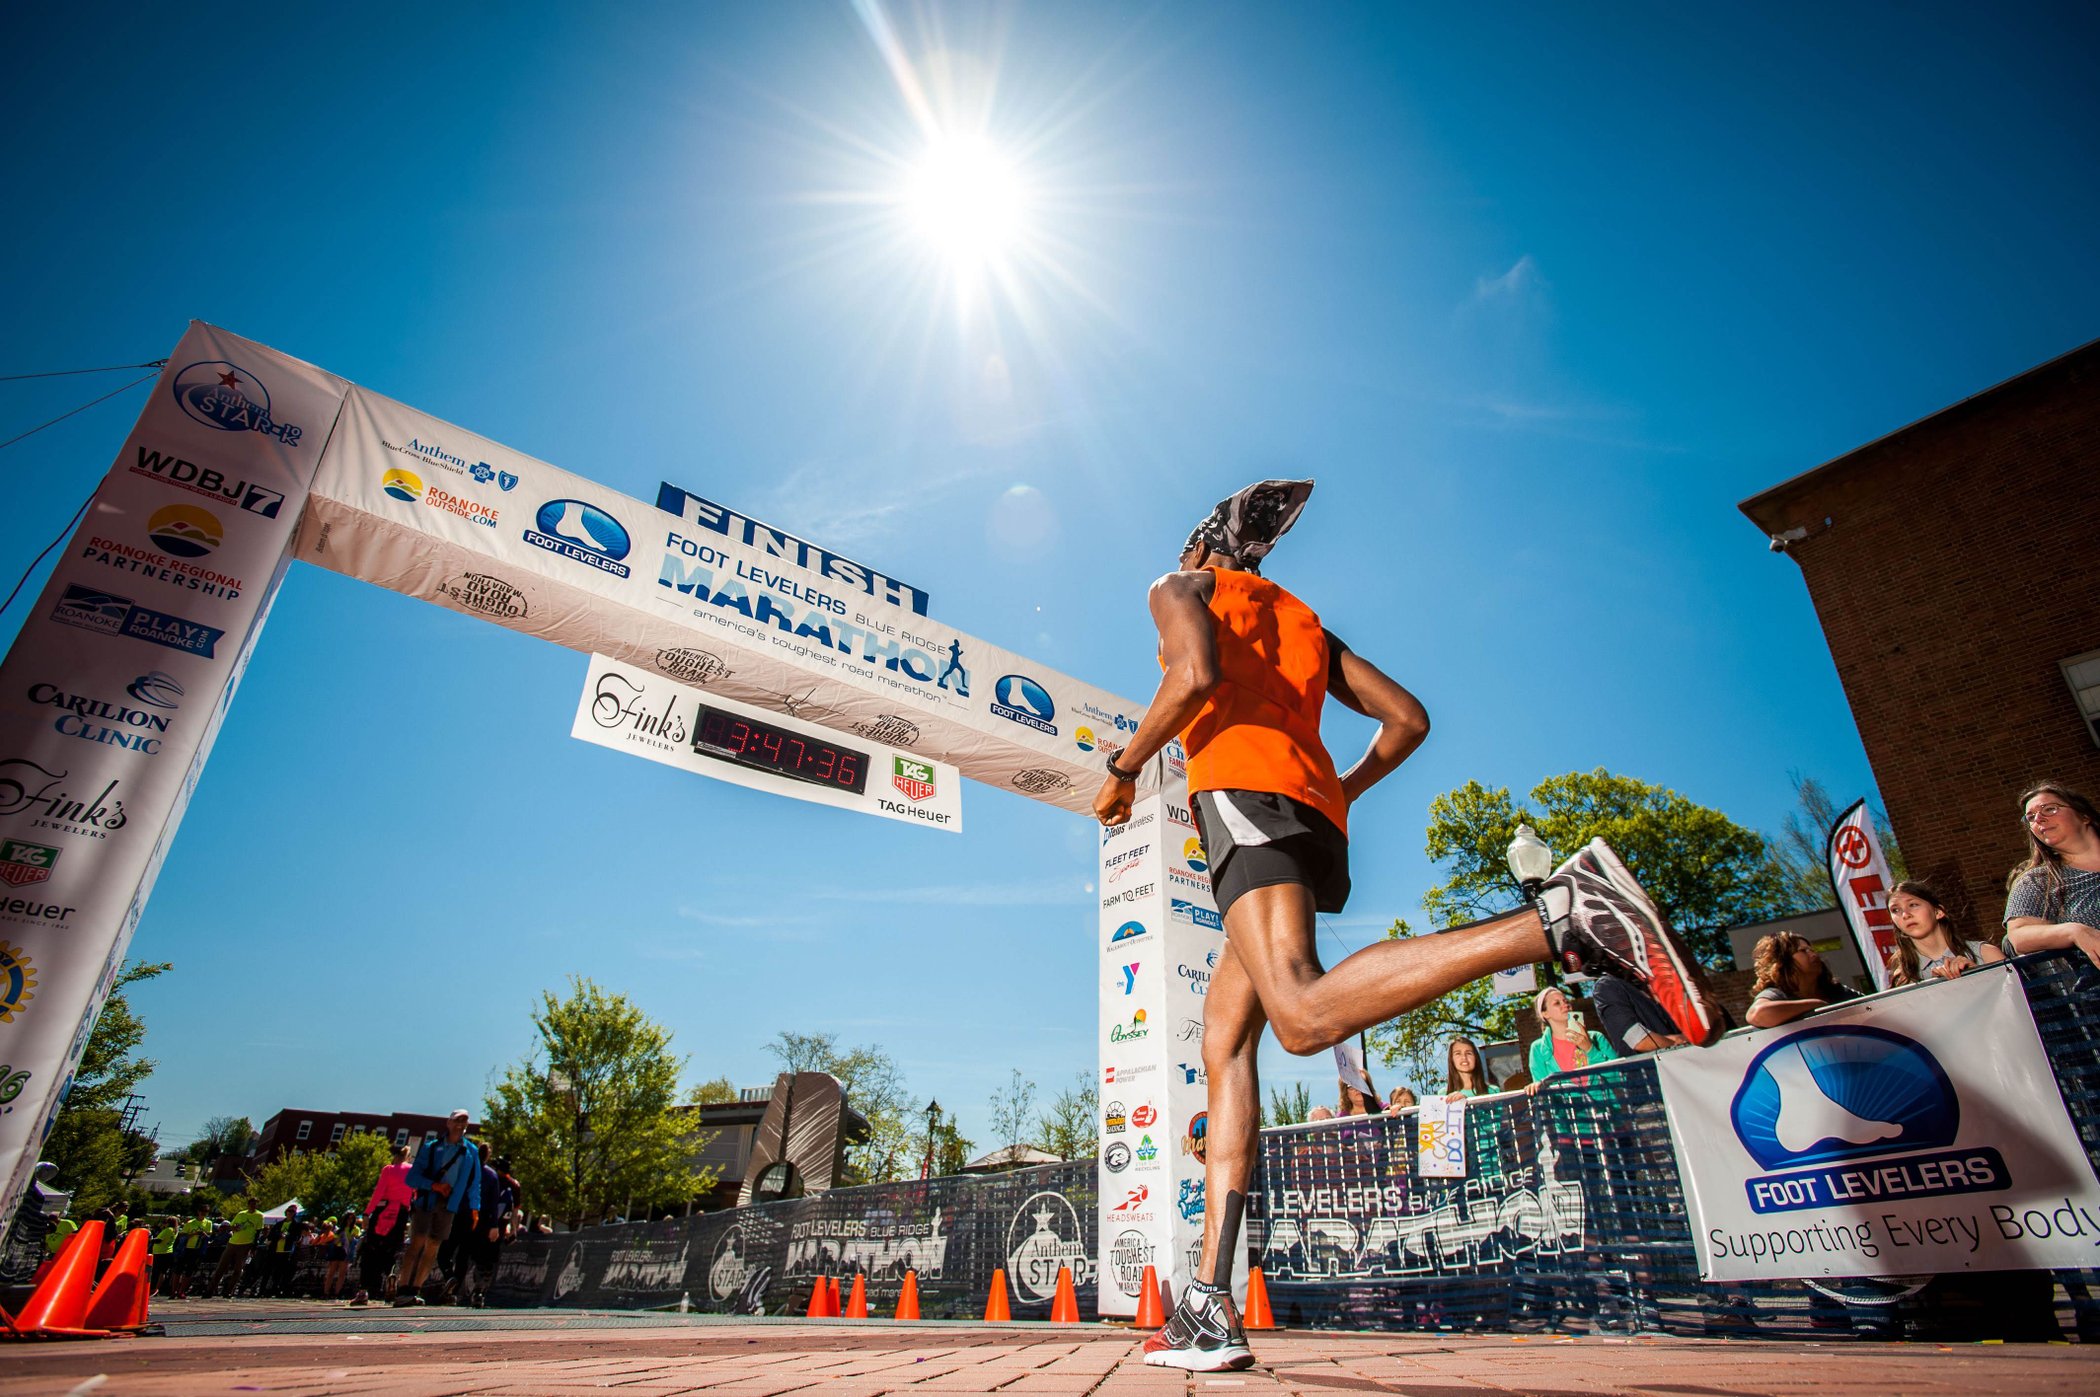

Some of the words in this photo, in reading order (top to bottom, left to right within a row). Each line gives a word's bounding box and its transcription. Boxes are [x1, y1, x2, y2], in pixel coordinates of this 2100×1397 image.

[207, 387, 269, 418] Anthem
[382, 440, 421, 460] BlueCross
[422, 456, 464, 476] BlueShield
[408, 438, 466, 467] Anthem
[425, 496, 497, 529] OUTSIDE.COM
[428, 486, 499, 521] ROANOKE
[89, 536, 167, 567] ROANOKE
[168, 560, 243, 590] REGIONAL
[527, 532, 563, 554] FOOT
[564, 547, 627, 577] LEVELERS
[682, 494, 914, 614] FINISH
[82, 547, 240, 600] PARTNERSHIP
[464, 572, 522, 598] MARATHON
[436, 583, 528, 619] TOUGHEST
[467, 581, 512, 604] ROAD
[666, 532, 730, 569] FOOT
[736, 560, 847, 615] LEVELERS
[855, 613, 896, 637] BLUE
[900, 631, 946, 655] RIDGE
[56, 606, 121, 629] ROANOKE
[134, 612, 200, 638] PLAY
[657, 553, 971, 698] MARATHON
[129, 625, 195, 648] ROANOKE
[657, 648, 736, 679] TOUGHEST
[692, 607, 767, 642] america's
[771, 636, 838, 668] toughest
[841, 661, 874, 680] road
[876, 671, 942, 704] marathon
[668, 662, 707, 680] ROAD
[28, 683, 172, 732] CARILION
[592, 673, 686, 743] Fink's
[992, 705, 1015, 718] FOOT
[1016, 712, 1056, 734] LEVELERS
[1083, 703, 1112, 720] Anthem
[54, 715, 162, 755] CLINIC
[875, 720, 909, 737] ROAD
[877, 714, 919, 732] MARATHON
[627, 733, 675, 752] JEWELERS
[900, 760, 929, 780] TAG
[0, 758, 128, 830] Fink's
[896, 778, 932, 799] HEUER
[878, 799, 905, 814] TAG
[908, 806, 951, 824] Heuer
[1128, 813, 1154, 830] wireless
[31, 819, 108, 840] JEWELERS
[10, 844, 50, 865] TAG
[1105, 853, 1127, 869] FLEET
[1128, 844, 1150, 859] FEET
[1169, 867, 1196, 881] ROANOKE
[1169, 875, 1211, 893] PARTNERS
[1103, 894, 1121, 909] FARM
[1135, 883, 1155, 898] FEET
[1194, 909, 1216, 922] PLAY
[1446, 1105, 1462, 1134] IT
[1420, 1122, 1435, 1153] YOU
[1432, 1120, 1447, 1159] CAN
[1447, 1139, 1463, 1162] DO
[1269, 1187, 1402, 1214] LEVELERS
[1409, 1189, 1457, 1212] BLUE
[1464, 1167, 1535, 1196] RIDGE
[1753, 1178, 1820, 1208] FOOT
[1825, 1156, 1995, 1201] LEVELERS
[791, 1223, 811, 1239] FOOT
[811, 1219, 867, 1237] LEVELERS
[871, 1225, 896, 1238] BLUE
[898, 1223, 930, 1235] RIDGE
[1107, 1213, 1154, 1222] HEADSWEATS
[1247, 1180, 1585, 1277] ARATHON
[1710, 1220, 1880, 1264] Supporting
[1881, 1209, 1981, 1253] Every
[1989, 1198, 2100, 1245] Body
[782, 1237, 948, 1281] MARATHON
[1031, 1238, 1082, 1258] Anthem
[1110, 1246, 1156, 1266] TOUGHEST
[1121, 1266, 1144, 1281] ROAD
